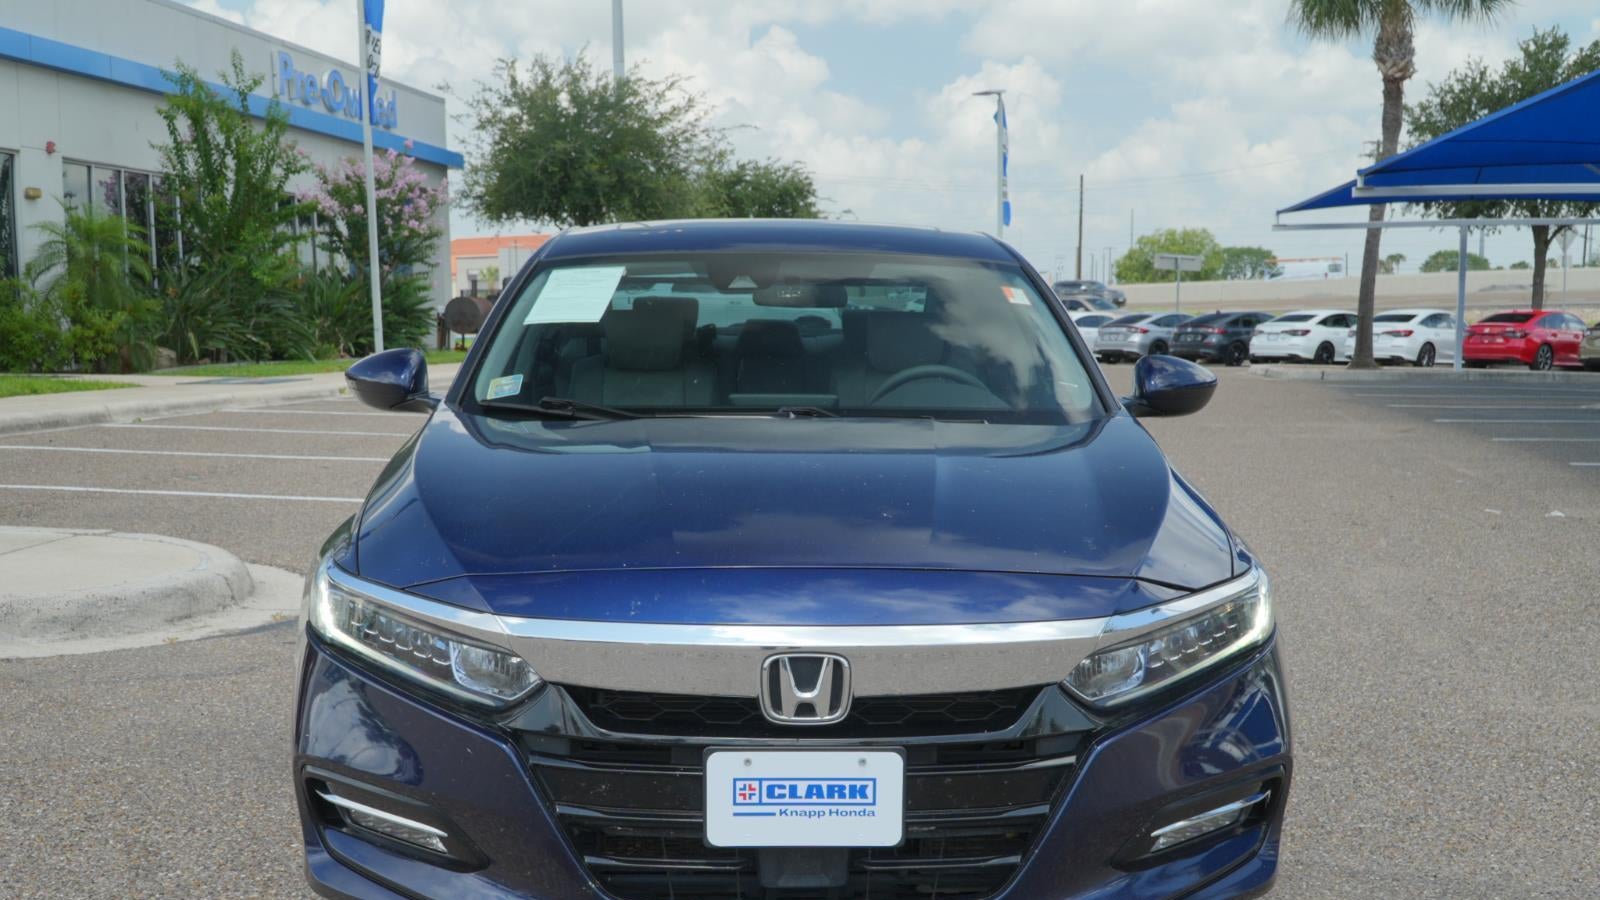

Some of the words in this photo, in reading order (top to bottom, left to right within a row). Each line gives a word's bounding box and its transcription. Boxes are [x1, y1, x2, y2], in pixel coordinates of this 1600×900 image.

[277, 50, 397, 129] Pre-Owed
[766, 784, 869, 800] CLARK
[779, 808, 826, 819] Knapp
[828, 808, 876, 817] Honda
